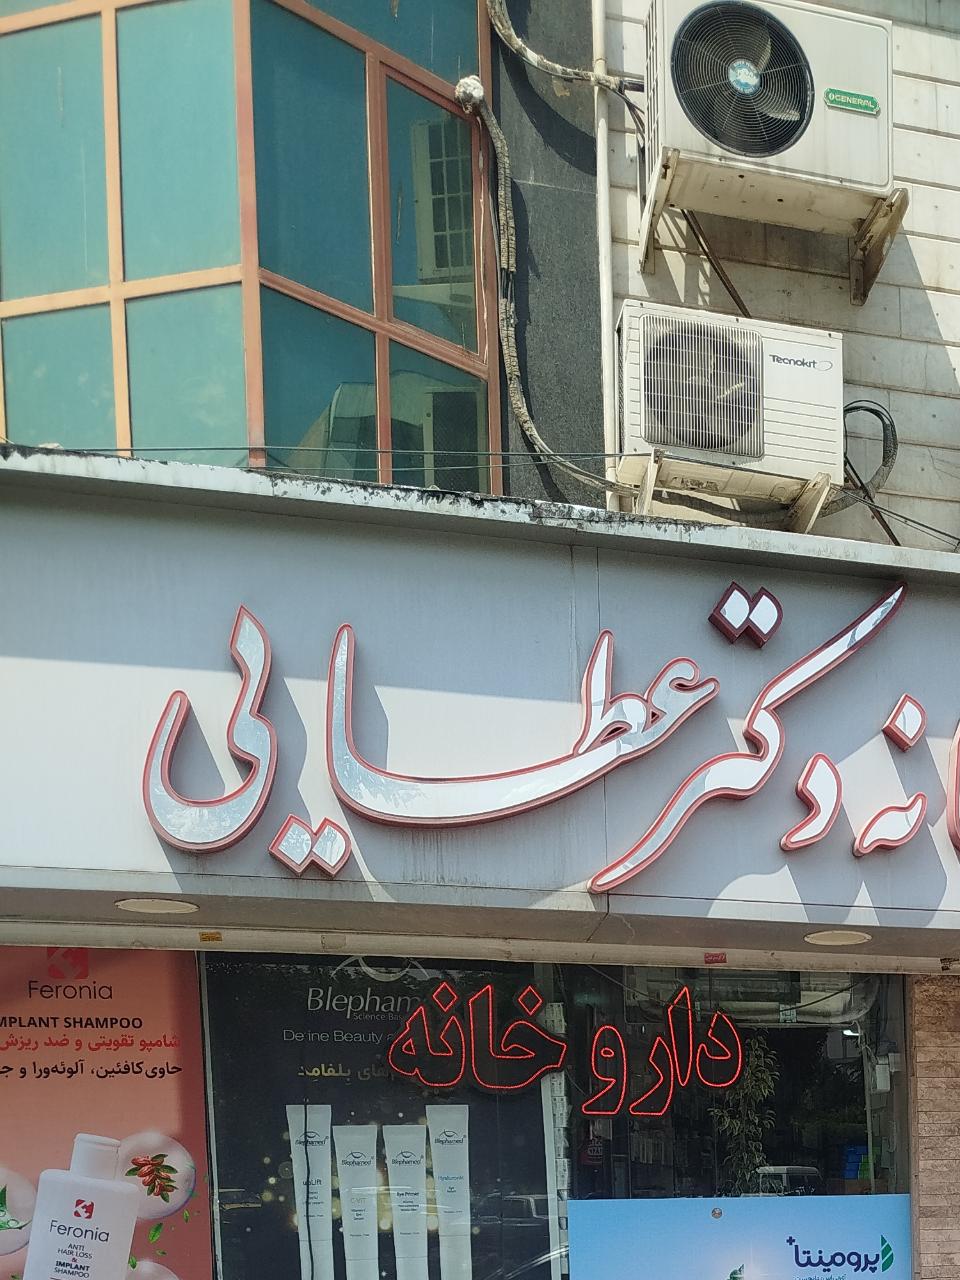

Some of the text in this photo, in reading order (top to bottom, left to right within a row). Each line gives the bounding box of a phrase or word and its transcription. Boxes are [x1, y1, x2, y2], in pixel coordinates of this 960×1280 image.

[769, 354, 817, 368] Tecnokit
[589, 580, 908, 894] دکتر
[28, 980, 113, 999] Feronia
[307, 986, 422, 1019] Blepham
[0, 1016, 143, 1029] MPLANT SHAMPOO
[0, 1033, 181, 1052] شامپو تقویتی و ضد ریزش
[283, 1029, 329, 1042] Deine
[334, 1030, 384, 1045] Beauty
[388, 981, 742, 1116] داروخانه
[19, 1067, 27, 1078] و
[145, 1062, 182, 1078] حاوی
[49, 1219, 110, 1242] Feronia
[58, 1248, 93, 1259] HAIR LOSS
[68, 1243, 85, 1251] ANTI
[54, 1266, 90, 1279] SHAMPOO
[55, 1260, 90, 1272] IMPLANT
